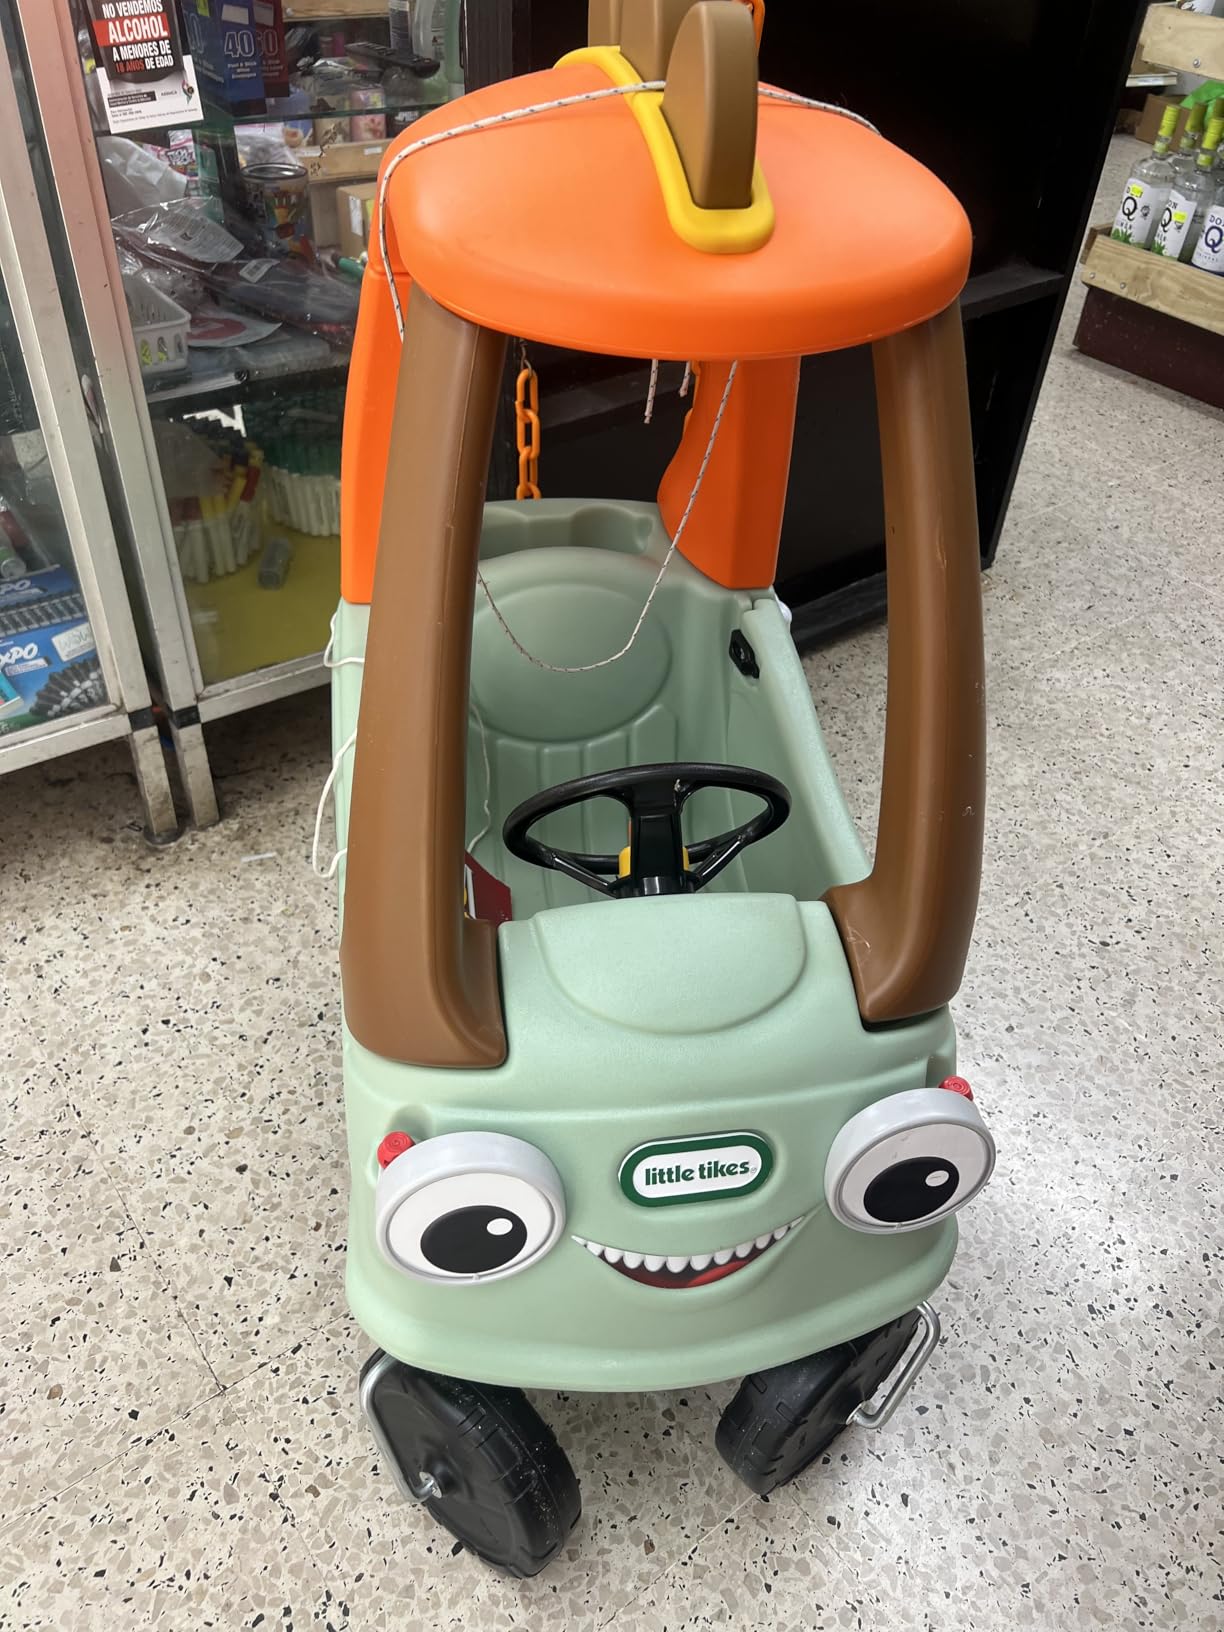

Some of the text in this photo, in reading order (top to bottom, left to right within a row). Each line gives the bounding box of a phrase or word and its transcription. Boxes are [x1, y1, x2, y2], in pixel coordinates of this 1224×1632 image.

[102, 0, 163, 19] NO VENDEMOS
[108, 15, 168, 43] ALCOHOL
[112, 40, 171, 62] A MENORES DE
[224, 30, 255, 58] 40
[115, 62, 125, 72] 18
[145, 57, 155, 70] DE
[155, 55, 174, 68] EDAD
[1122, 196, 1137, 222] Q
[1160, 207, 1172, 233] Q
[1204, 225, 1224, 254] Q
[645, 1160, 750, 1186] little tikes
